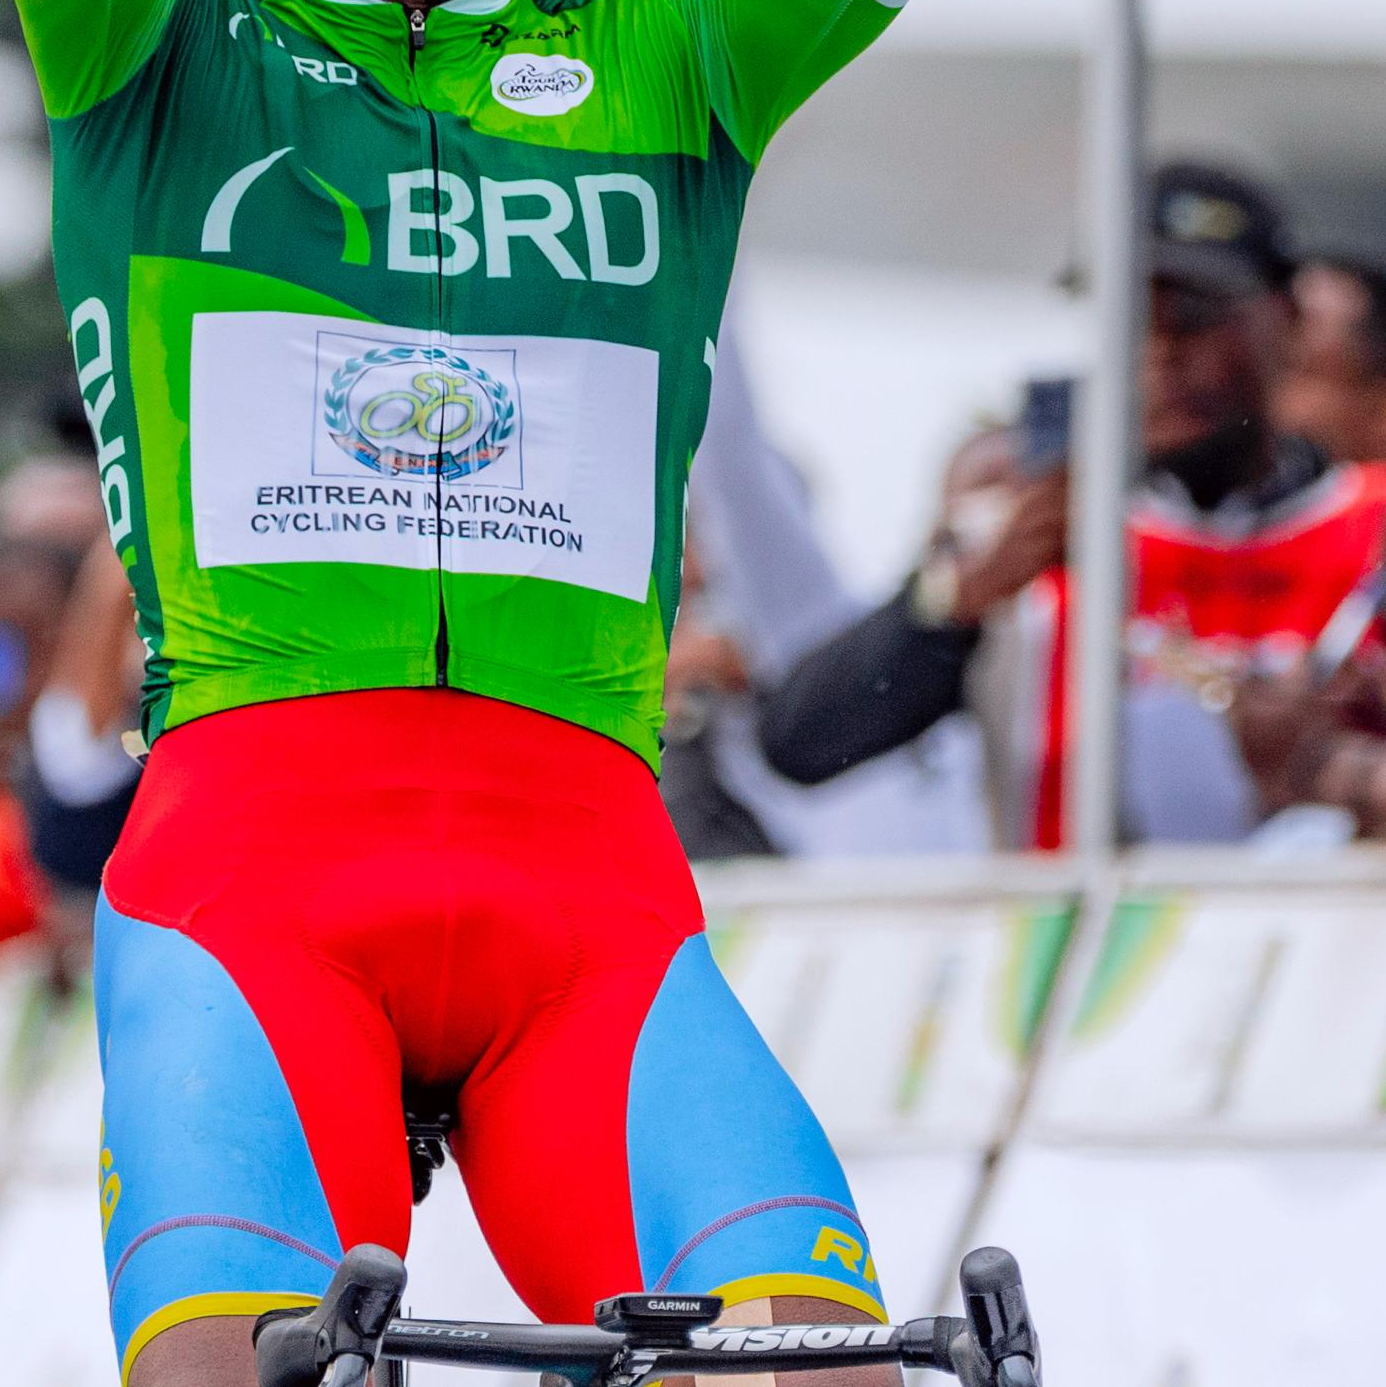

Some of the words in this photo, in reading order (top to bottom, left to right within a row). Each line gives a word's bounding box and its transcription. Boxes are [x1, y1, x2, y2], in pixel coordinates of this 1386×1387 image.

[276, 34, 357, 86] RD
[510, 79, 575, 93] RWANDA
[386, 169, 661, 286] BRD
[256, 485, 412, 510] ERITREAN
[423, 490, 572, 524] NATIONAL
[250, 513, 387, 535] CYCLING
[397, 515, 584, 553] FEDERATION
[647, 1300, 700, 1311] GARMIN
[691, 1325, 899, 1352] vision
